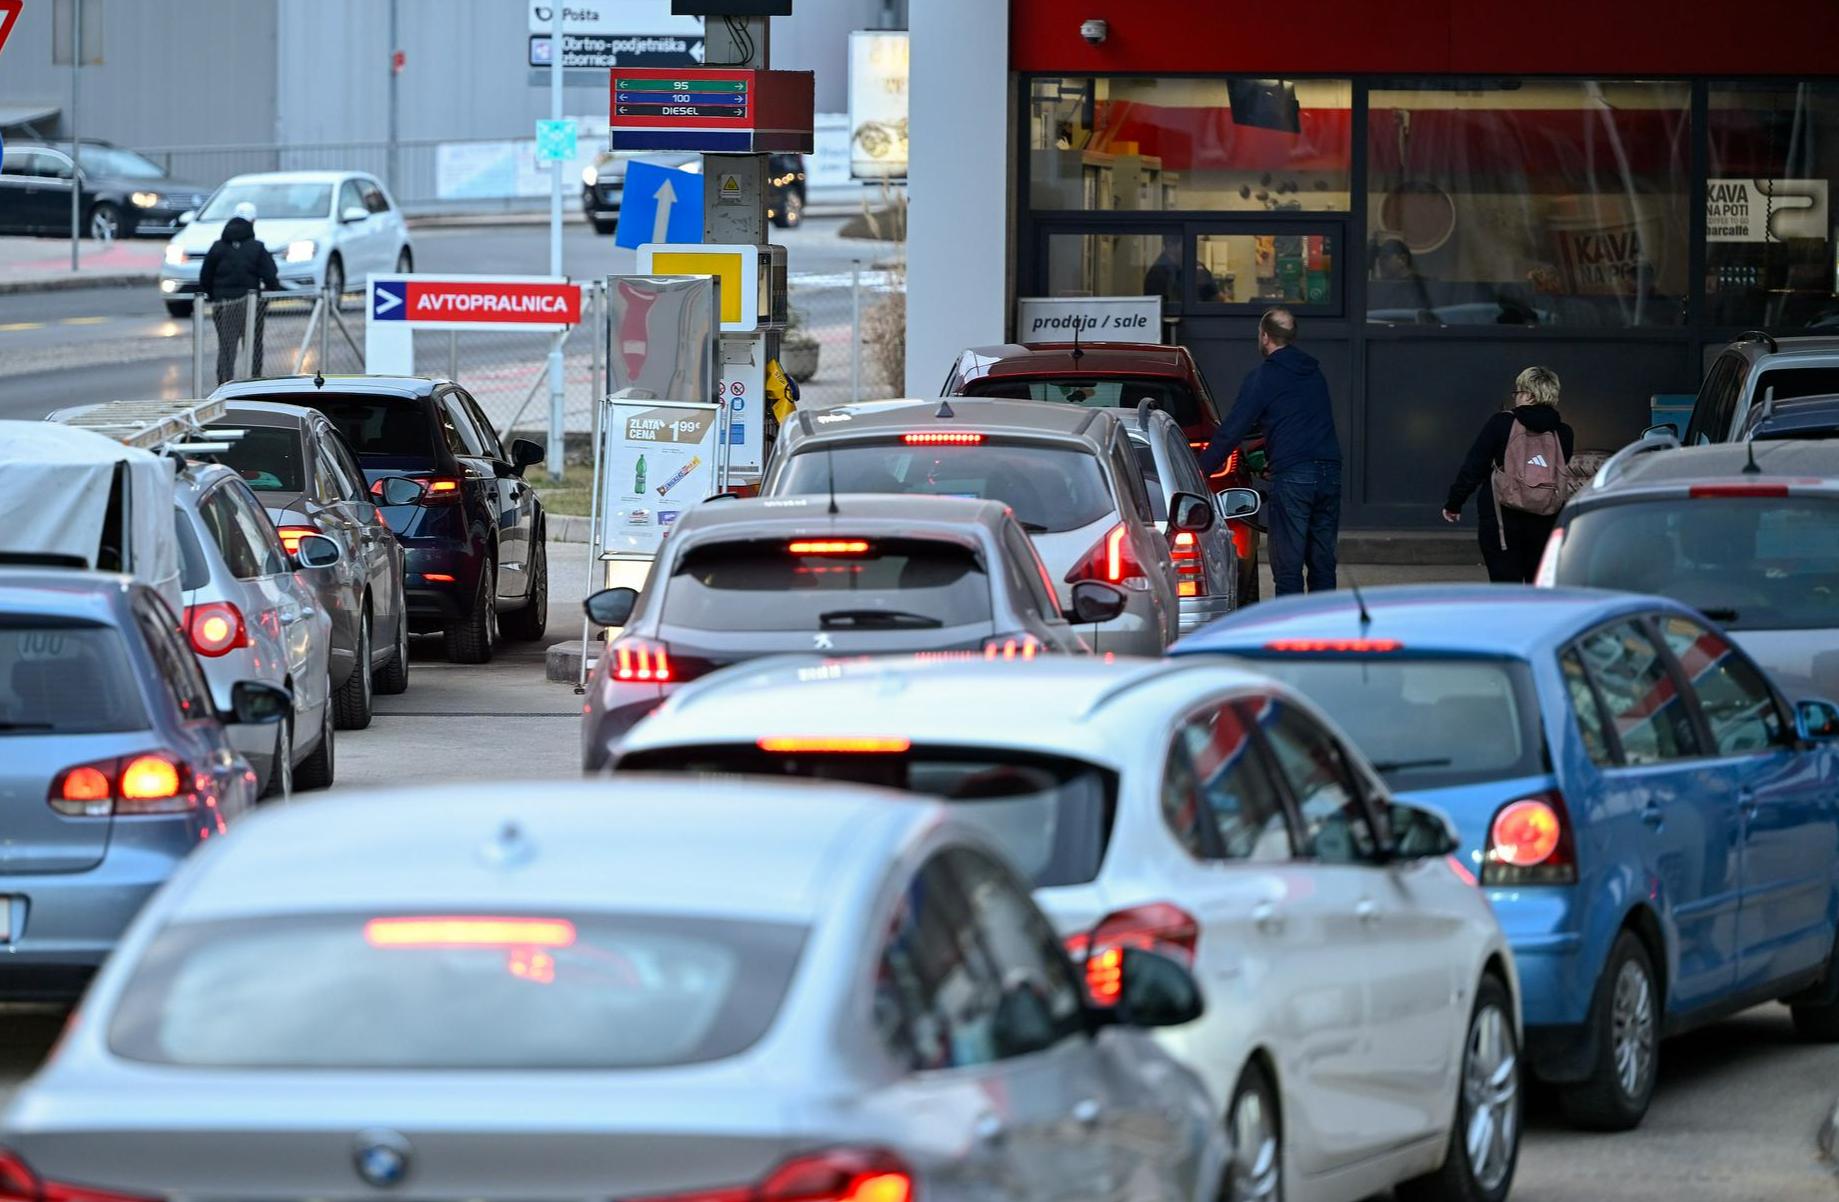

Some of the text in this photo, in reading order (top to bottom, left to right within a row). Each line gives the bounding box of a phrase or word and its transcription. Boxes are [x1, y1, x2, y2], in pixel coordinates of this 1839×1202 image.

[562, 8, 599, 21] Pošta
[563, 37, 686, 54] Obrtno-podjetniška
[562, 53, 616, 66] zbornica
[674, 81, 689, 90] 95
[672, 94, 690, 103] 100
[662, 107, 699, 115] DIESEL
[1706, 184, 1749, 203] KAVA
[1723, 204, 1749, 217] POTI
[417, 293, 568, 312] AVTOPRALNICA
[1032, 314, 1147, 332] prodaja / sale
[630, 418, 660, 430] ZLATA
[629, 429, 656, 440] CENA
